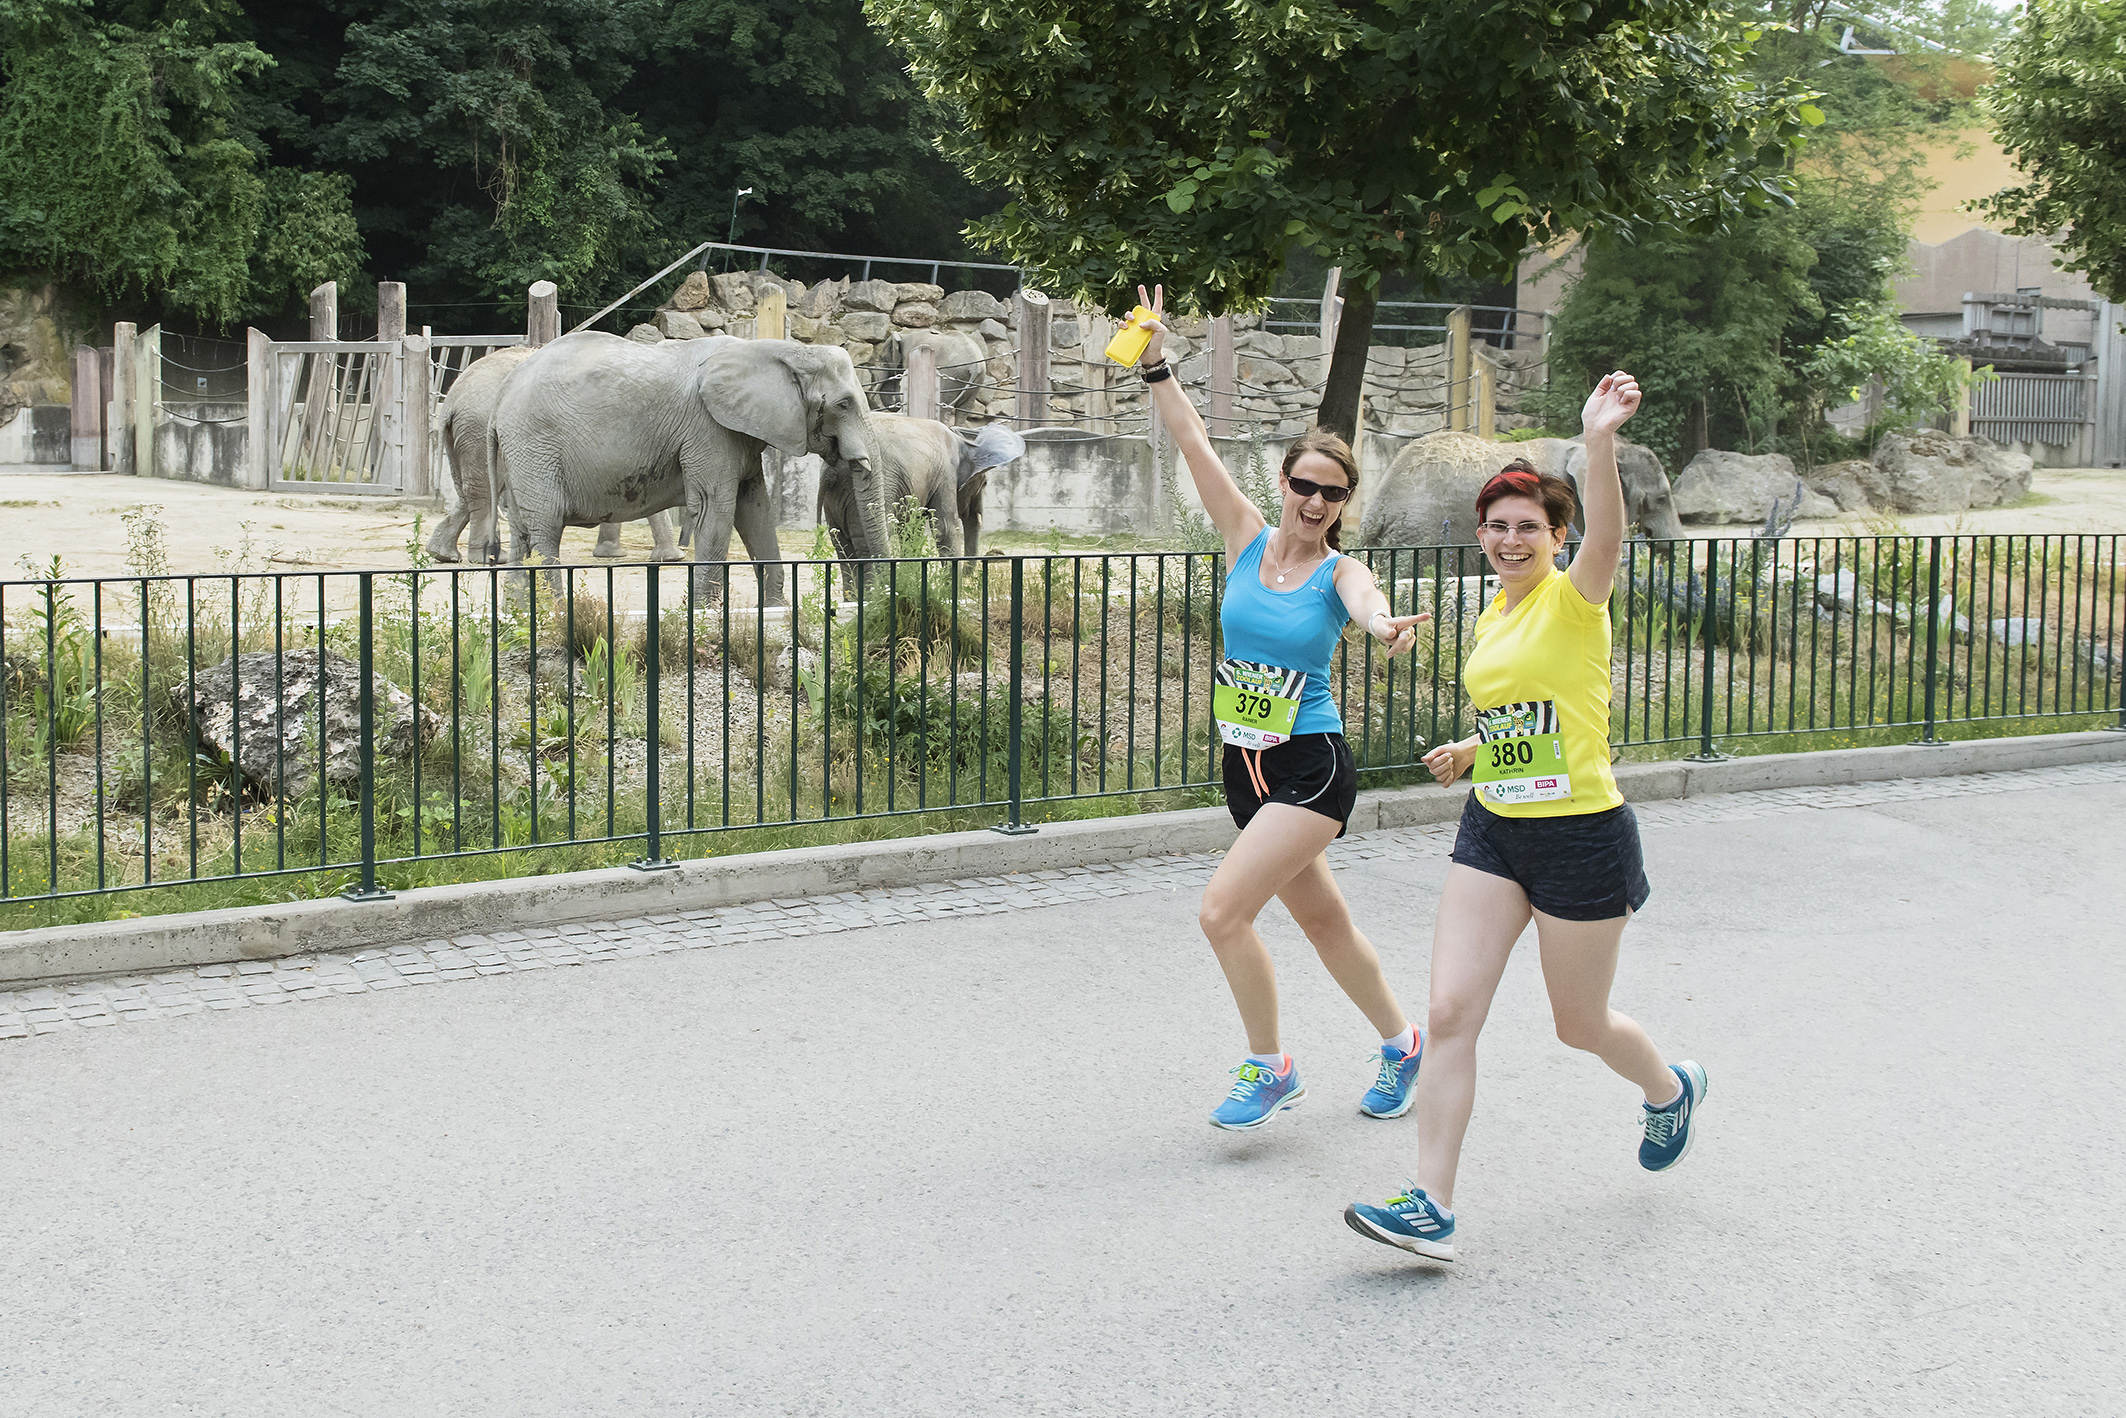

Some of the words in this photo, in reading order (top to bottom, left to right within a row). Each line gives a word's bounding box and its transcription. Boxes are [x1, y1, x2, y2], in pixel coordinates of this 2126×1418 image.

[1236, 675, 1263, 685] ZOOLAUF
[1235, 693, 1271, 718] 379
[1242, 716, 1258, 724] RAINER
[1243, 732, 1256, 740] MSD
[1491, 741, 1533, 767] 380
[1499, 767, 1525, 775] KATHRIN
[1507, 785, 1526, 793] MSD
